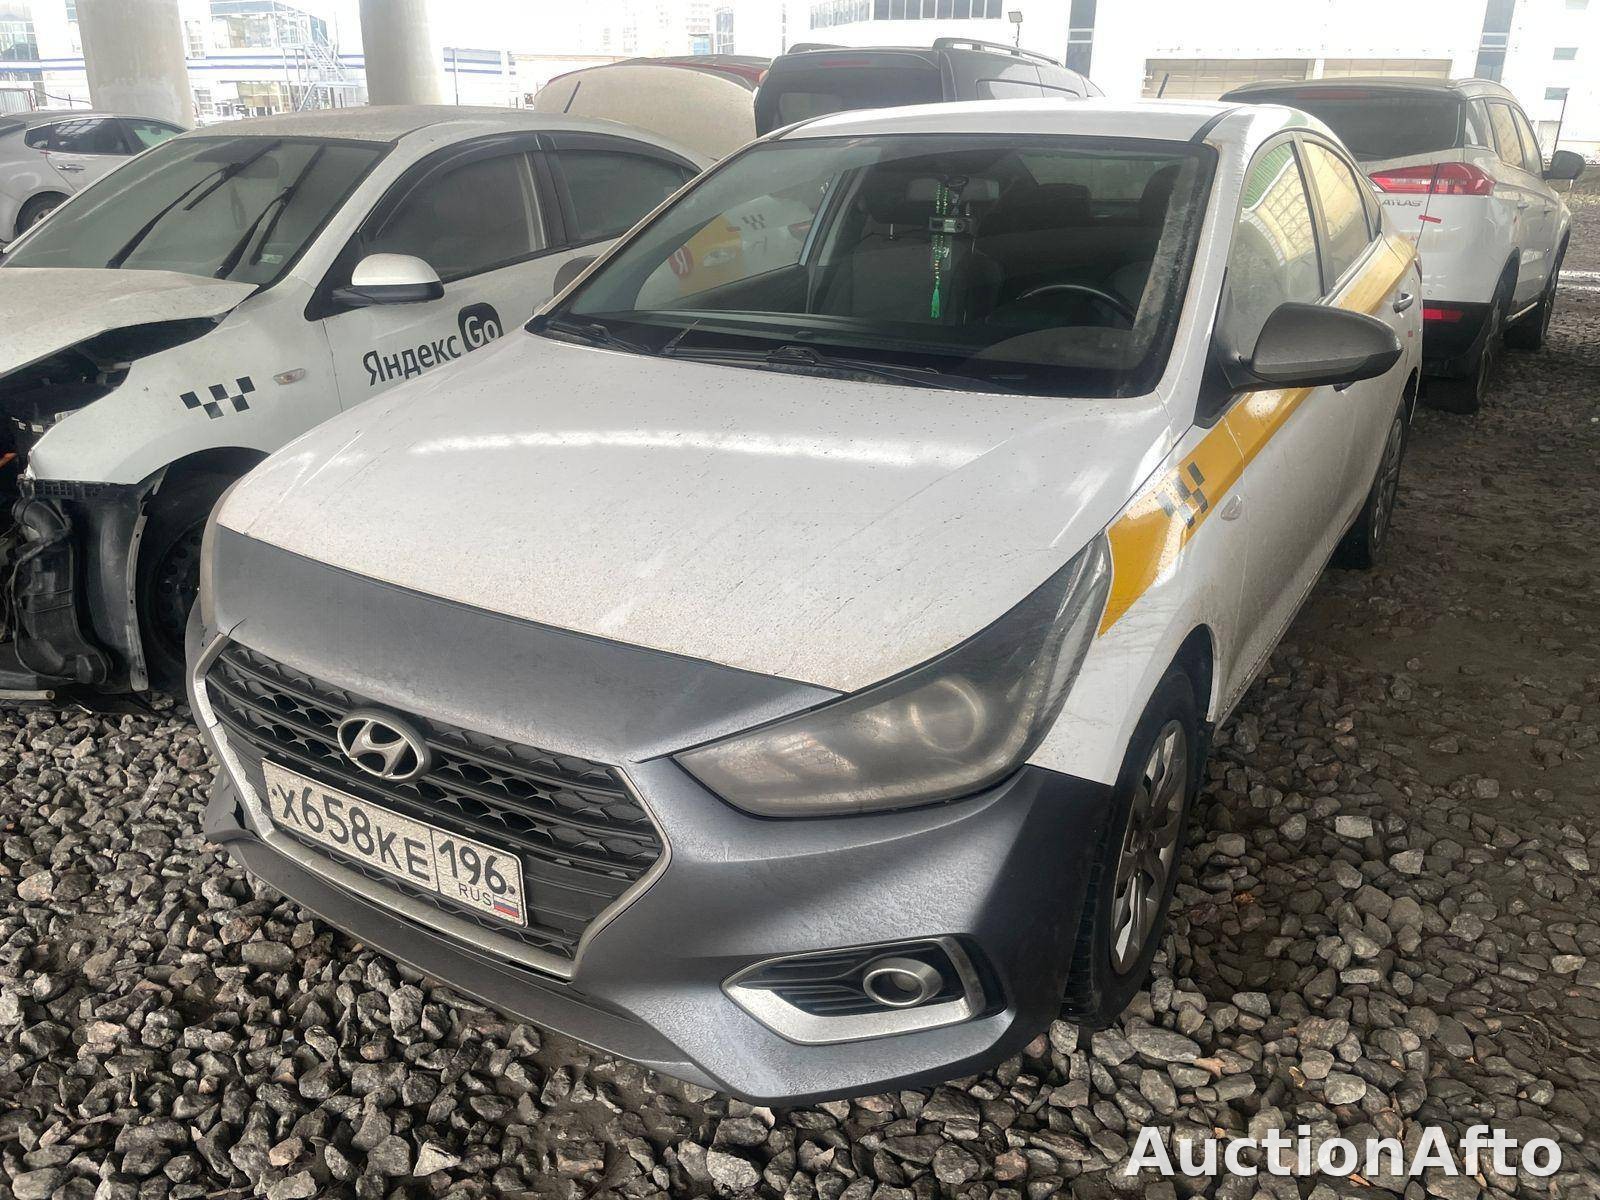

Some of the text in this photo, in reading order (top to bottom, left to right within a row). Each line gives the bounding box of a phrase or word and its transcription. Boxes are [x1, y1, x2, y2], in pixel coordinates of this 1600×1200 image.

[363, 316, 499, 387] Яндекс Go
[438, 840, 507, 895] 196
[458, 882, 492, 907] RUS
